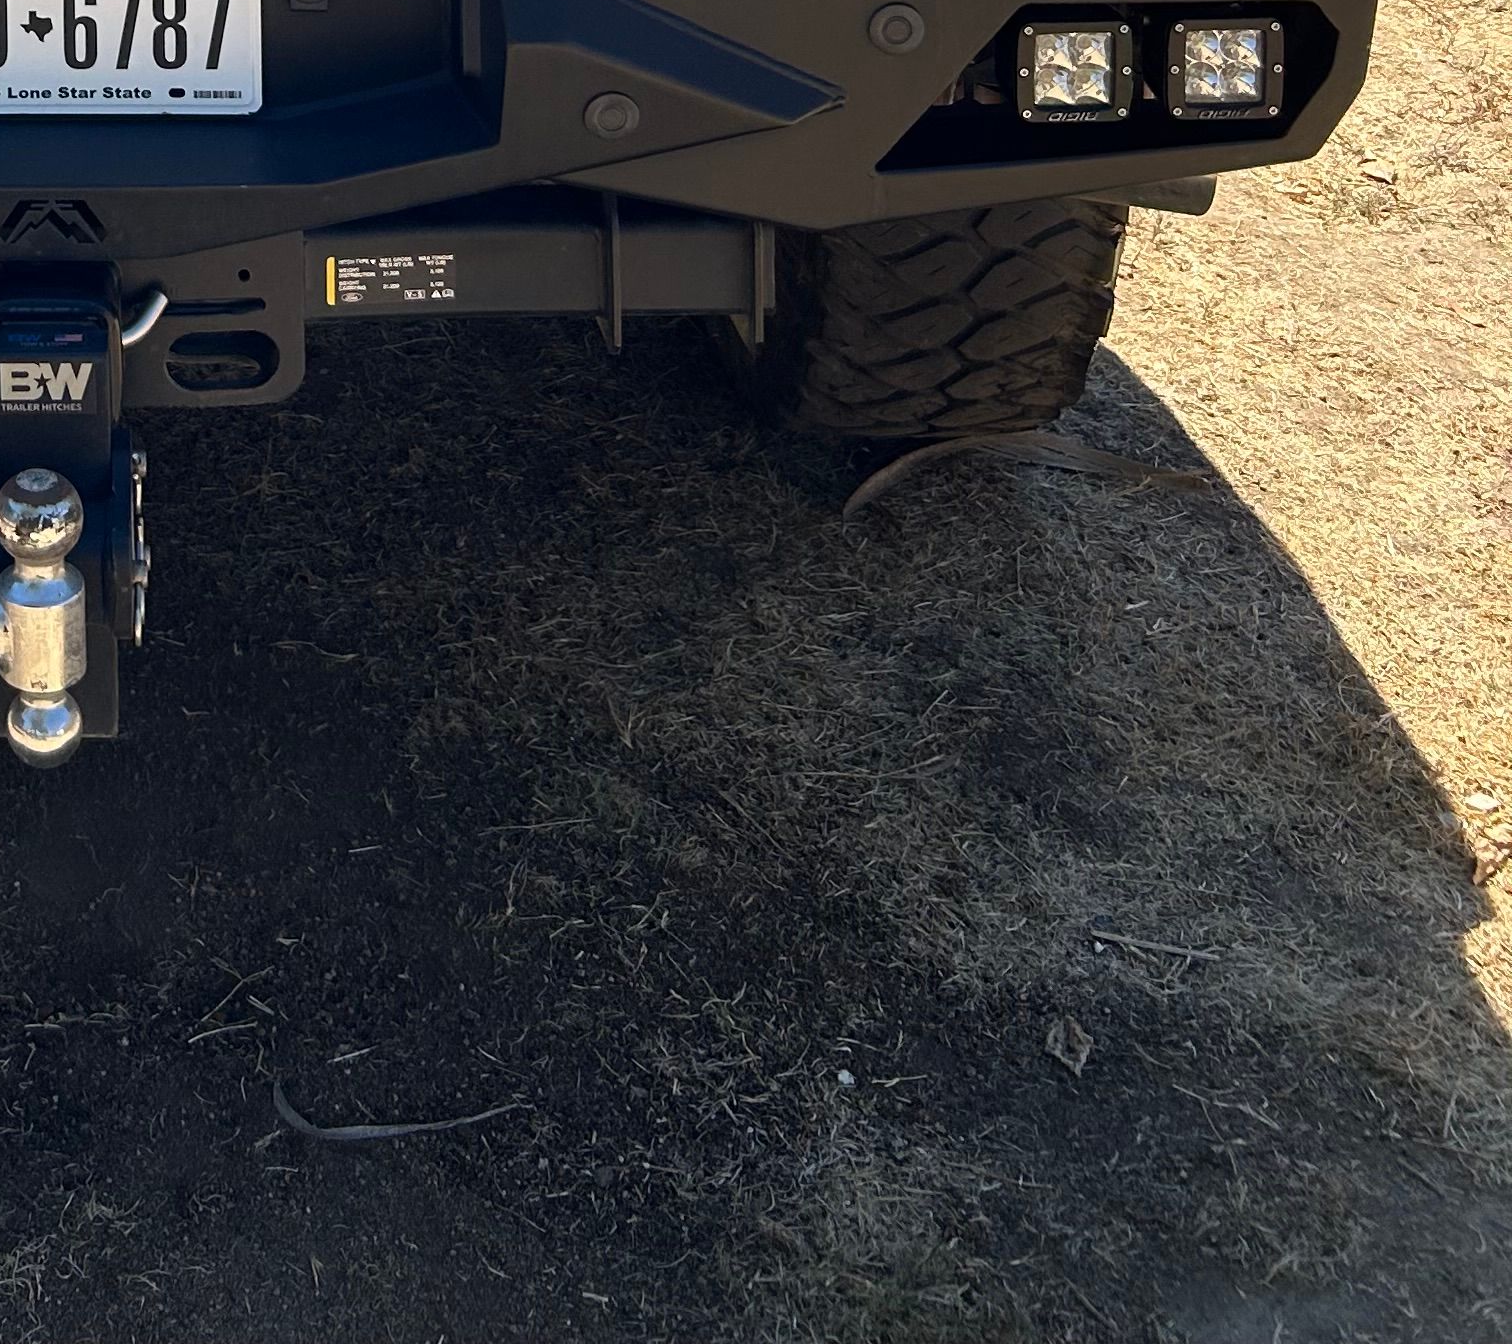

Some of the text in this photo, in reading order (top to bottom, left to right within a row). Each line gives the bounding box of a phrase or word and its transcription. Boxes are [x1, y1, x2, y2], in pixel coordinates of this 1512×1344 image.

[7, 86, 53, 100] Lone
[57, 86, 97, 100] Star
[102, 86, 153, 100] State
[1, 402, 83, 412] TRAILER HITCHES
